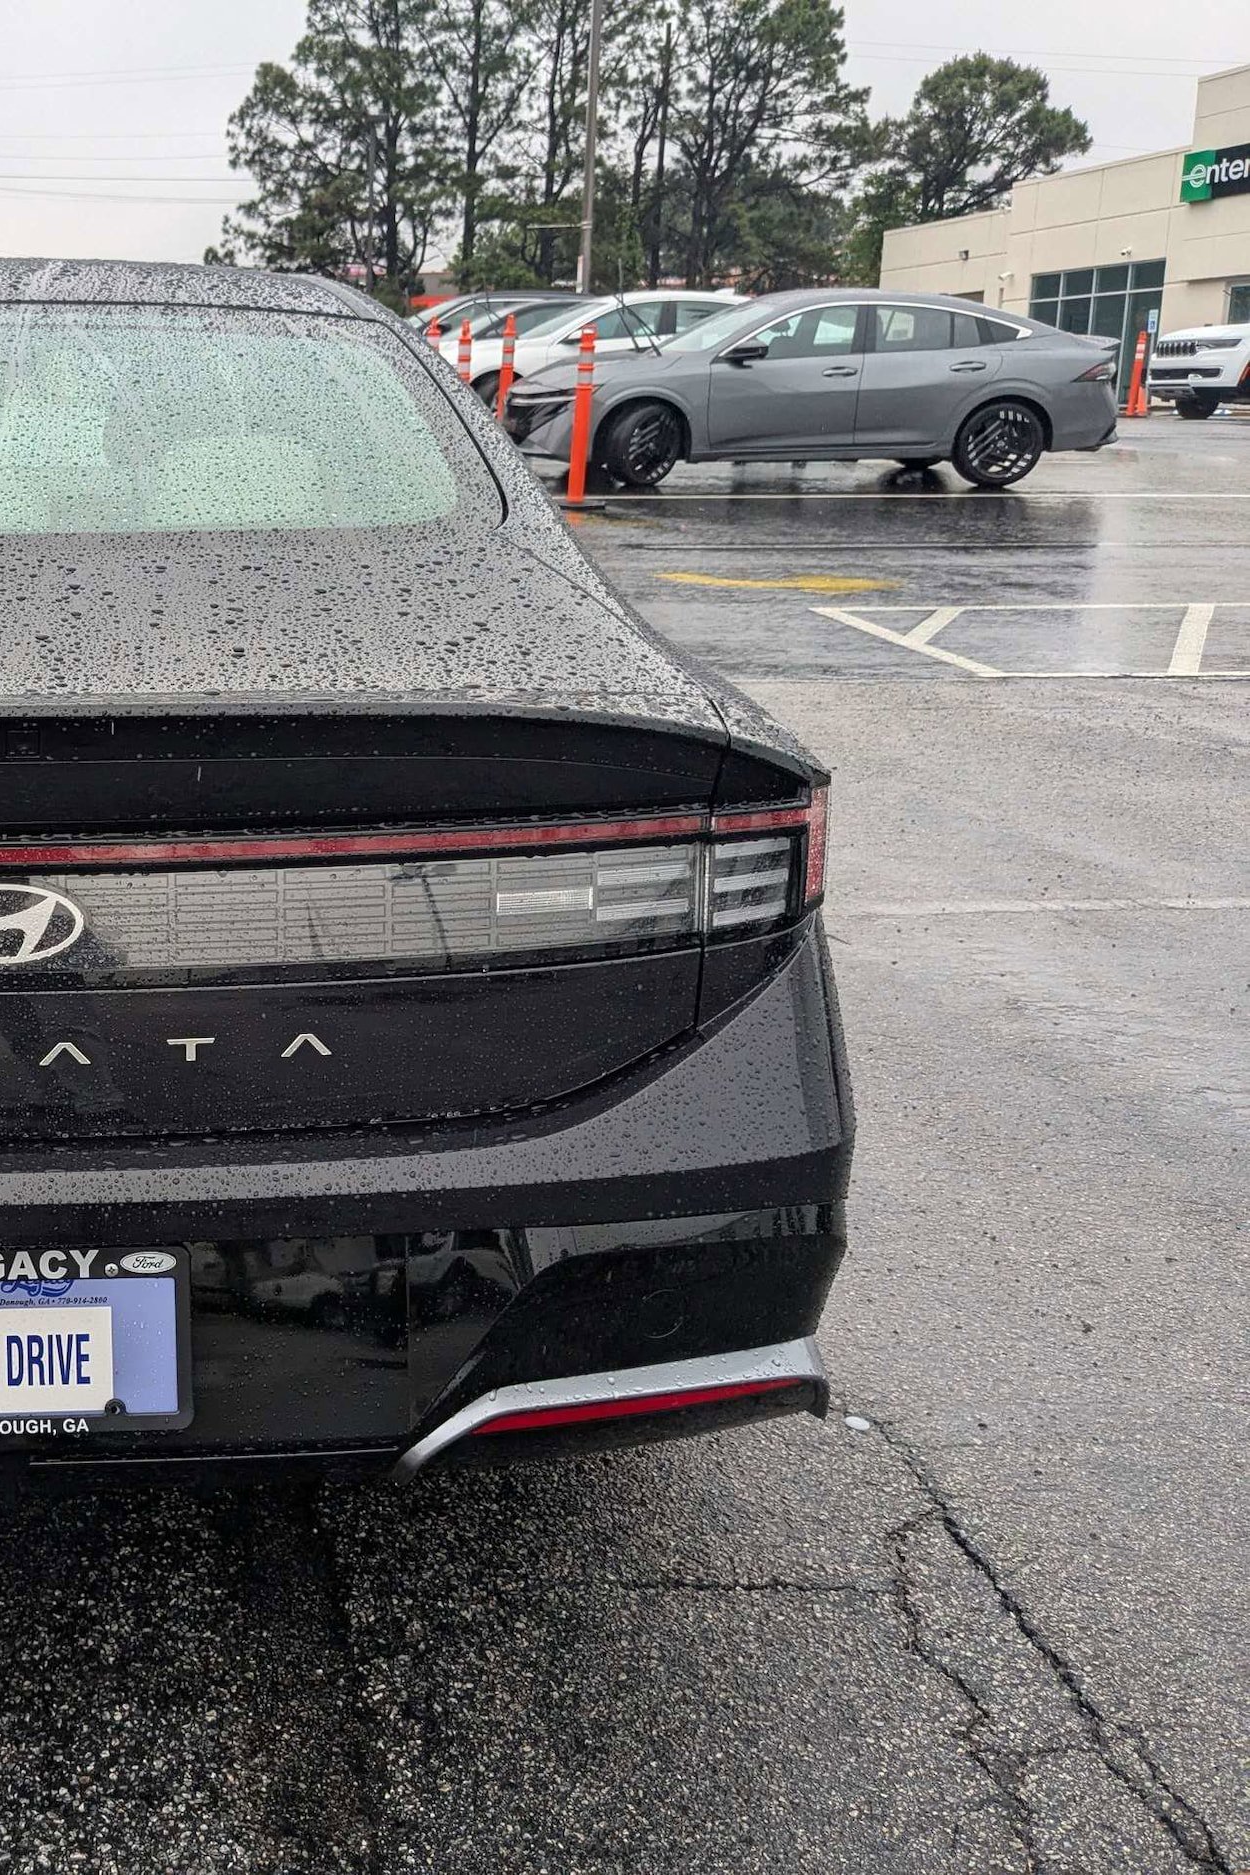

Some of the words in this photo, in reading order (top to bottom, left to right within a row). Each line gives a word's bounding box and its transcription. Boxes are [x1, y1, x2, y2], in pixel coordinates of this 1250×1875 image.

[38, 1297, 51, 1306] GA
[6, 1333, 91, 1387] DRIVE
[62, 1418, 90, 1434] GA
